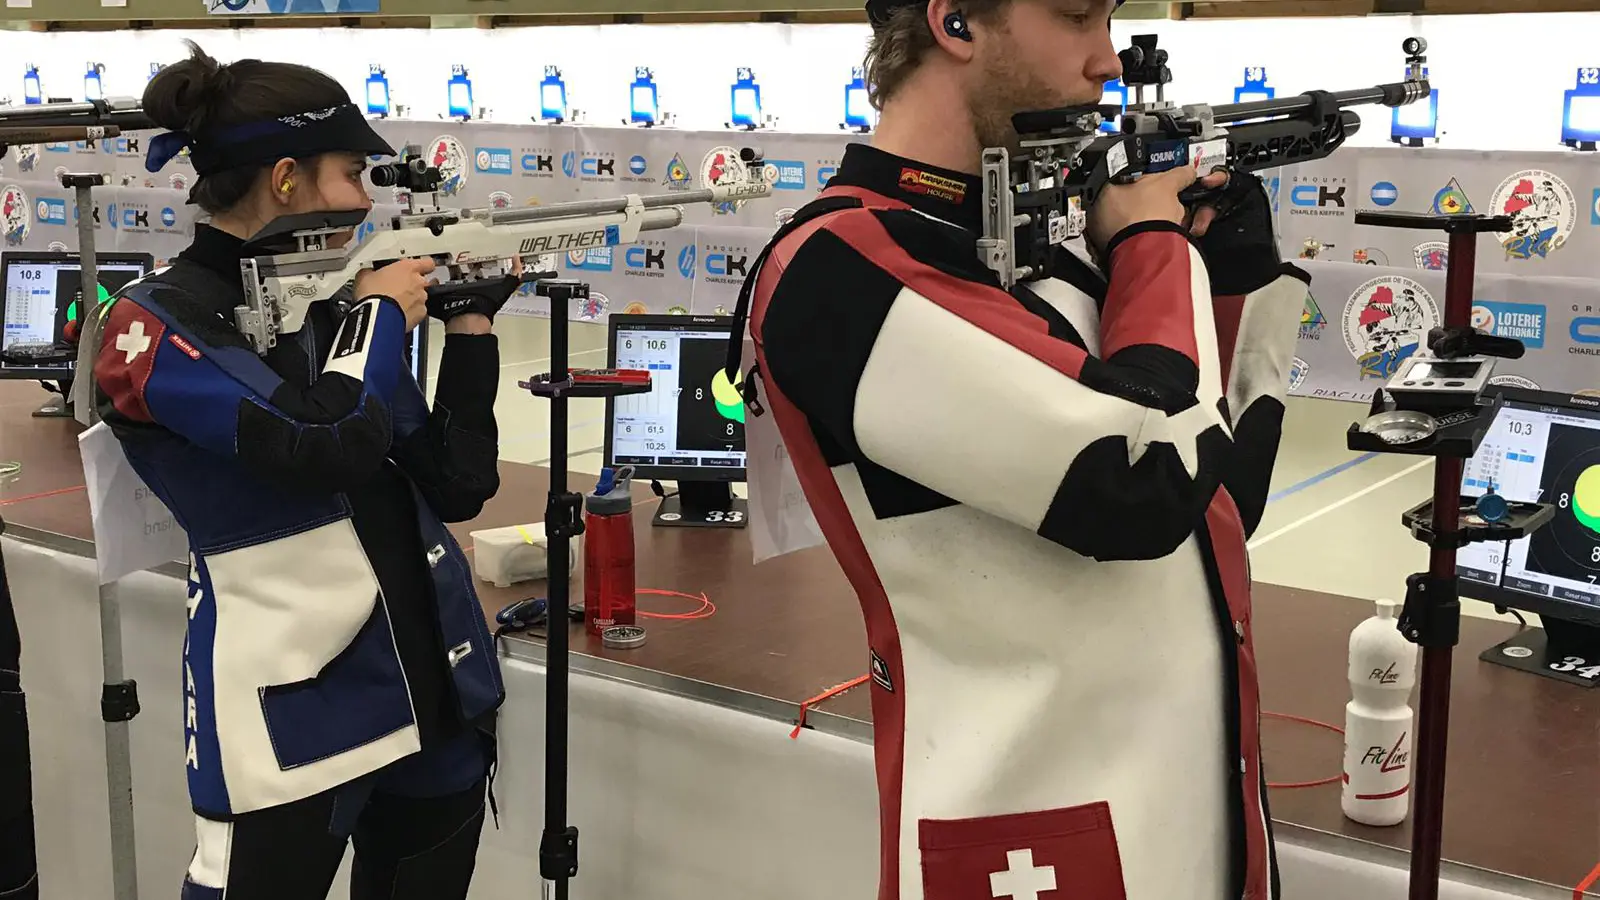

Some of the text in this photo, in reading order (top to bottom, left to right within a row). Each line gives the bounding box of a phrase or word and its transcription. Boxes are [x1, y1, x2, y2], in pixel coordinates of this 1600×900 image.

[545, 65, 557, 76] 24
[636, 66, 648, 78] 25
[738, 67, 751, 80] 26
[1247, 67, 1263, 81] 30
[1580, 68, 1598, 83] 32
[521, 154, 553, 171] CK
[1150, 150, 1175, 163] SCHUNK
[581, 158, 615, 175] CK
[727, 184, 767, 197] LG400
[1290, 185, 1346, 208] CK
[123, 209, 149, 227] CK
[518, 230, 605, 253] WALTHER
[625, 247, 665, 270] CK
[705, 254, 747, 277] CK
[20, 269, 41, 280] 10,8
[444, 298, 472, 310] LEKI
[1498, 312, 1542, 328] LOTERIE
[1497, 326, 1541, 339] NATIONALE
[625, 339, 632, 349] 6
[647, 340, 667, 351] 10,6
[1568, 346, 1600, 356] CHARLE
[695, 388, 703, 400] 8
[1569, 396, 1599, 407] lenovo
[1435, 411, 1474, 426] UISSE
[625, 425, 632, 433] 6
[647, 425, 664, 435] 61,5
[726, 423, 734, 435] 8
[1508, 420, 1533, 436] 10,3
[645, 442, 666, 451] 10,25
[1559, 493, 1569, 508] 8
[705, 510, 744, 523] 33
[1591, 546, 1600, 562] 8
[1368, 661, 1399, 684] FitLine
[1549, 656, 1600, 679] 34
[1361, 731, 1408, 772] FitLine
